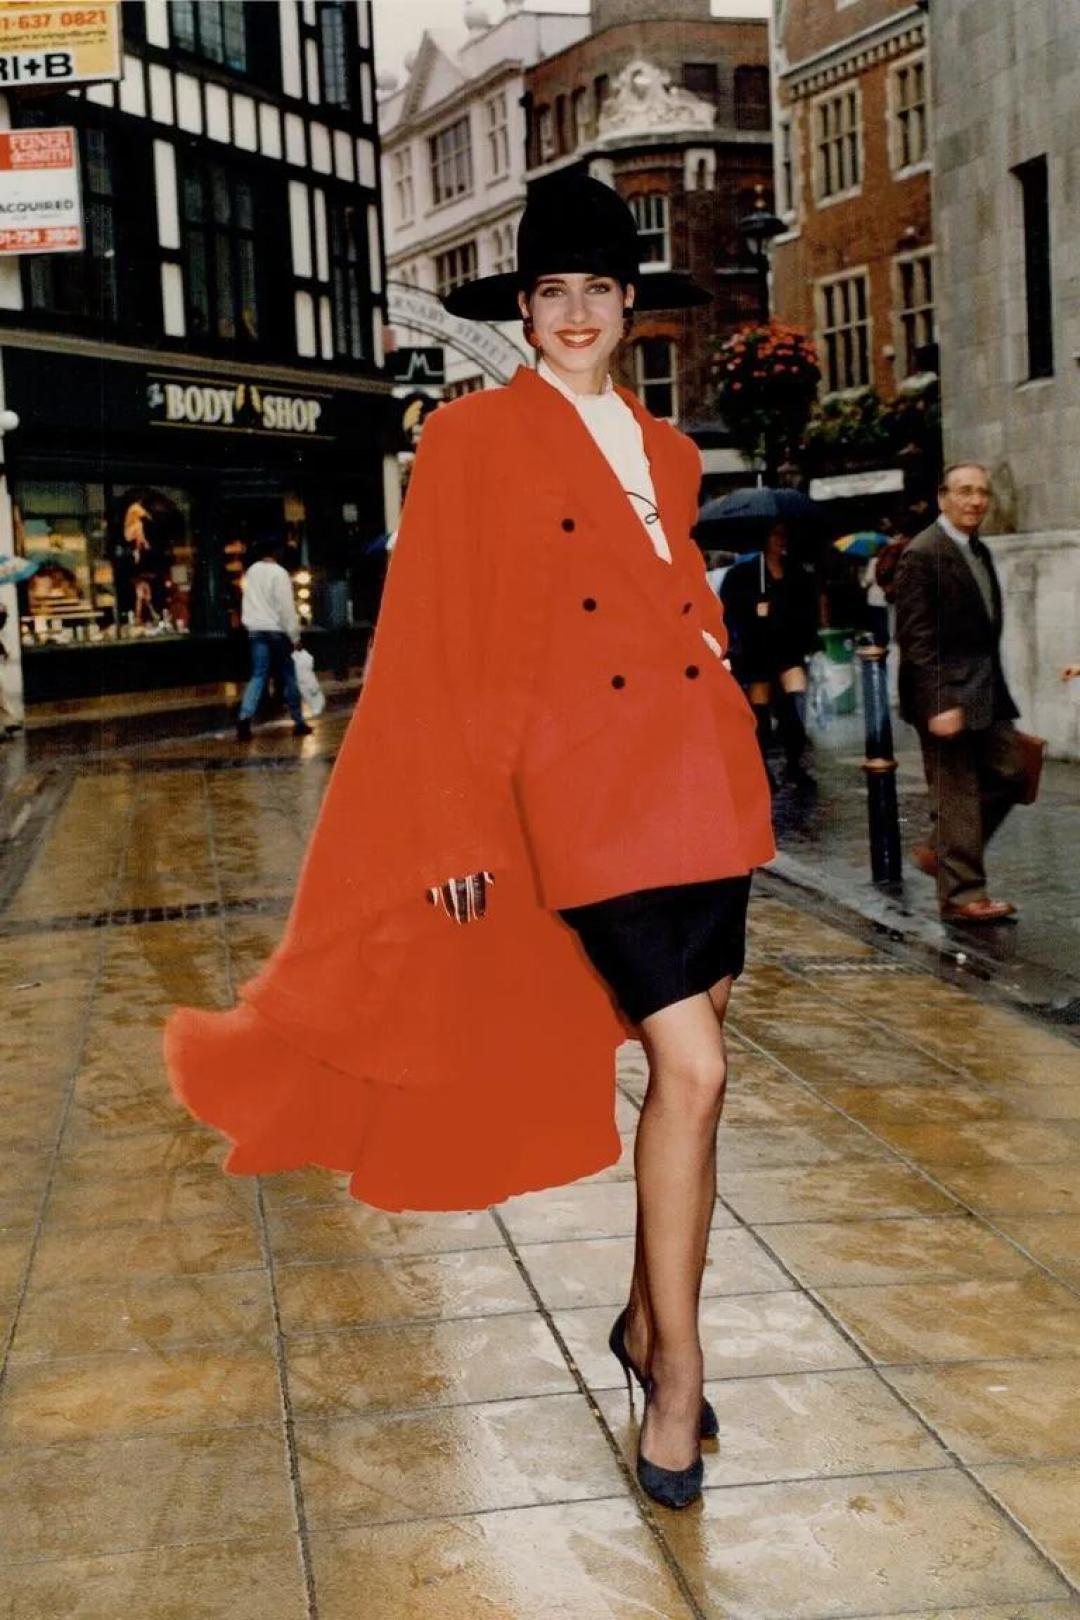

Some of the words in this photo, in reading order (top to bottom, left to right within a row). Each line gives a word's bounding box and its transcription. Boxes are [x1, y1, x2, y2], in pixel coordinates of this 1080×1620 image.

[60, 9, 107, 27] 0821
[165, 383, 236, 424] BODY
[262, 394, 322, 432] SHOP
